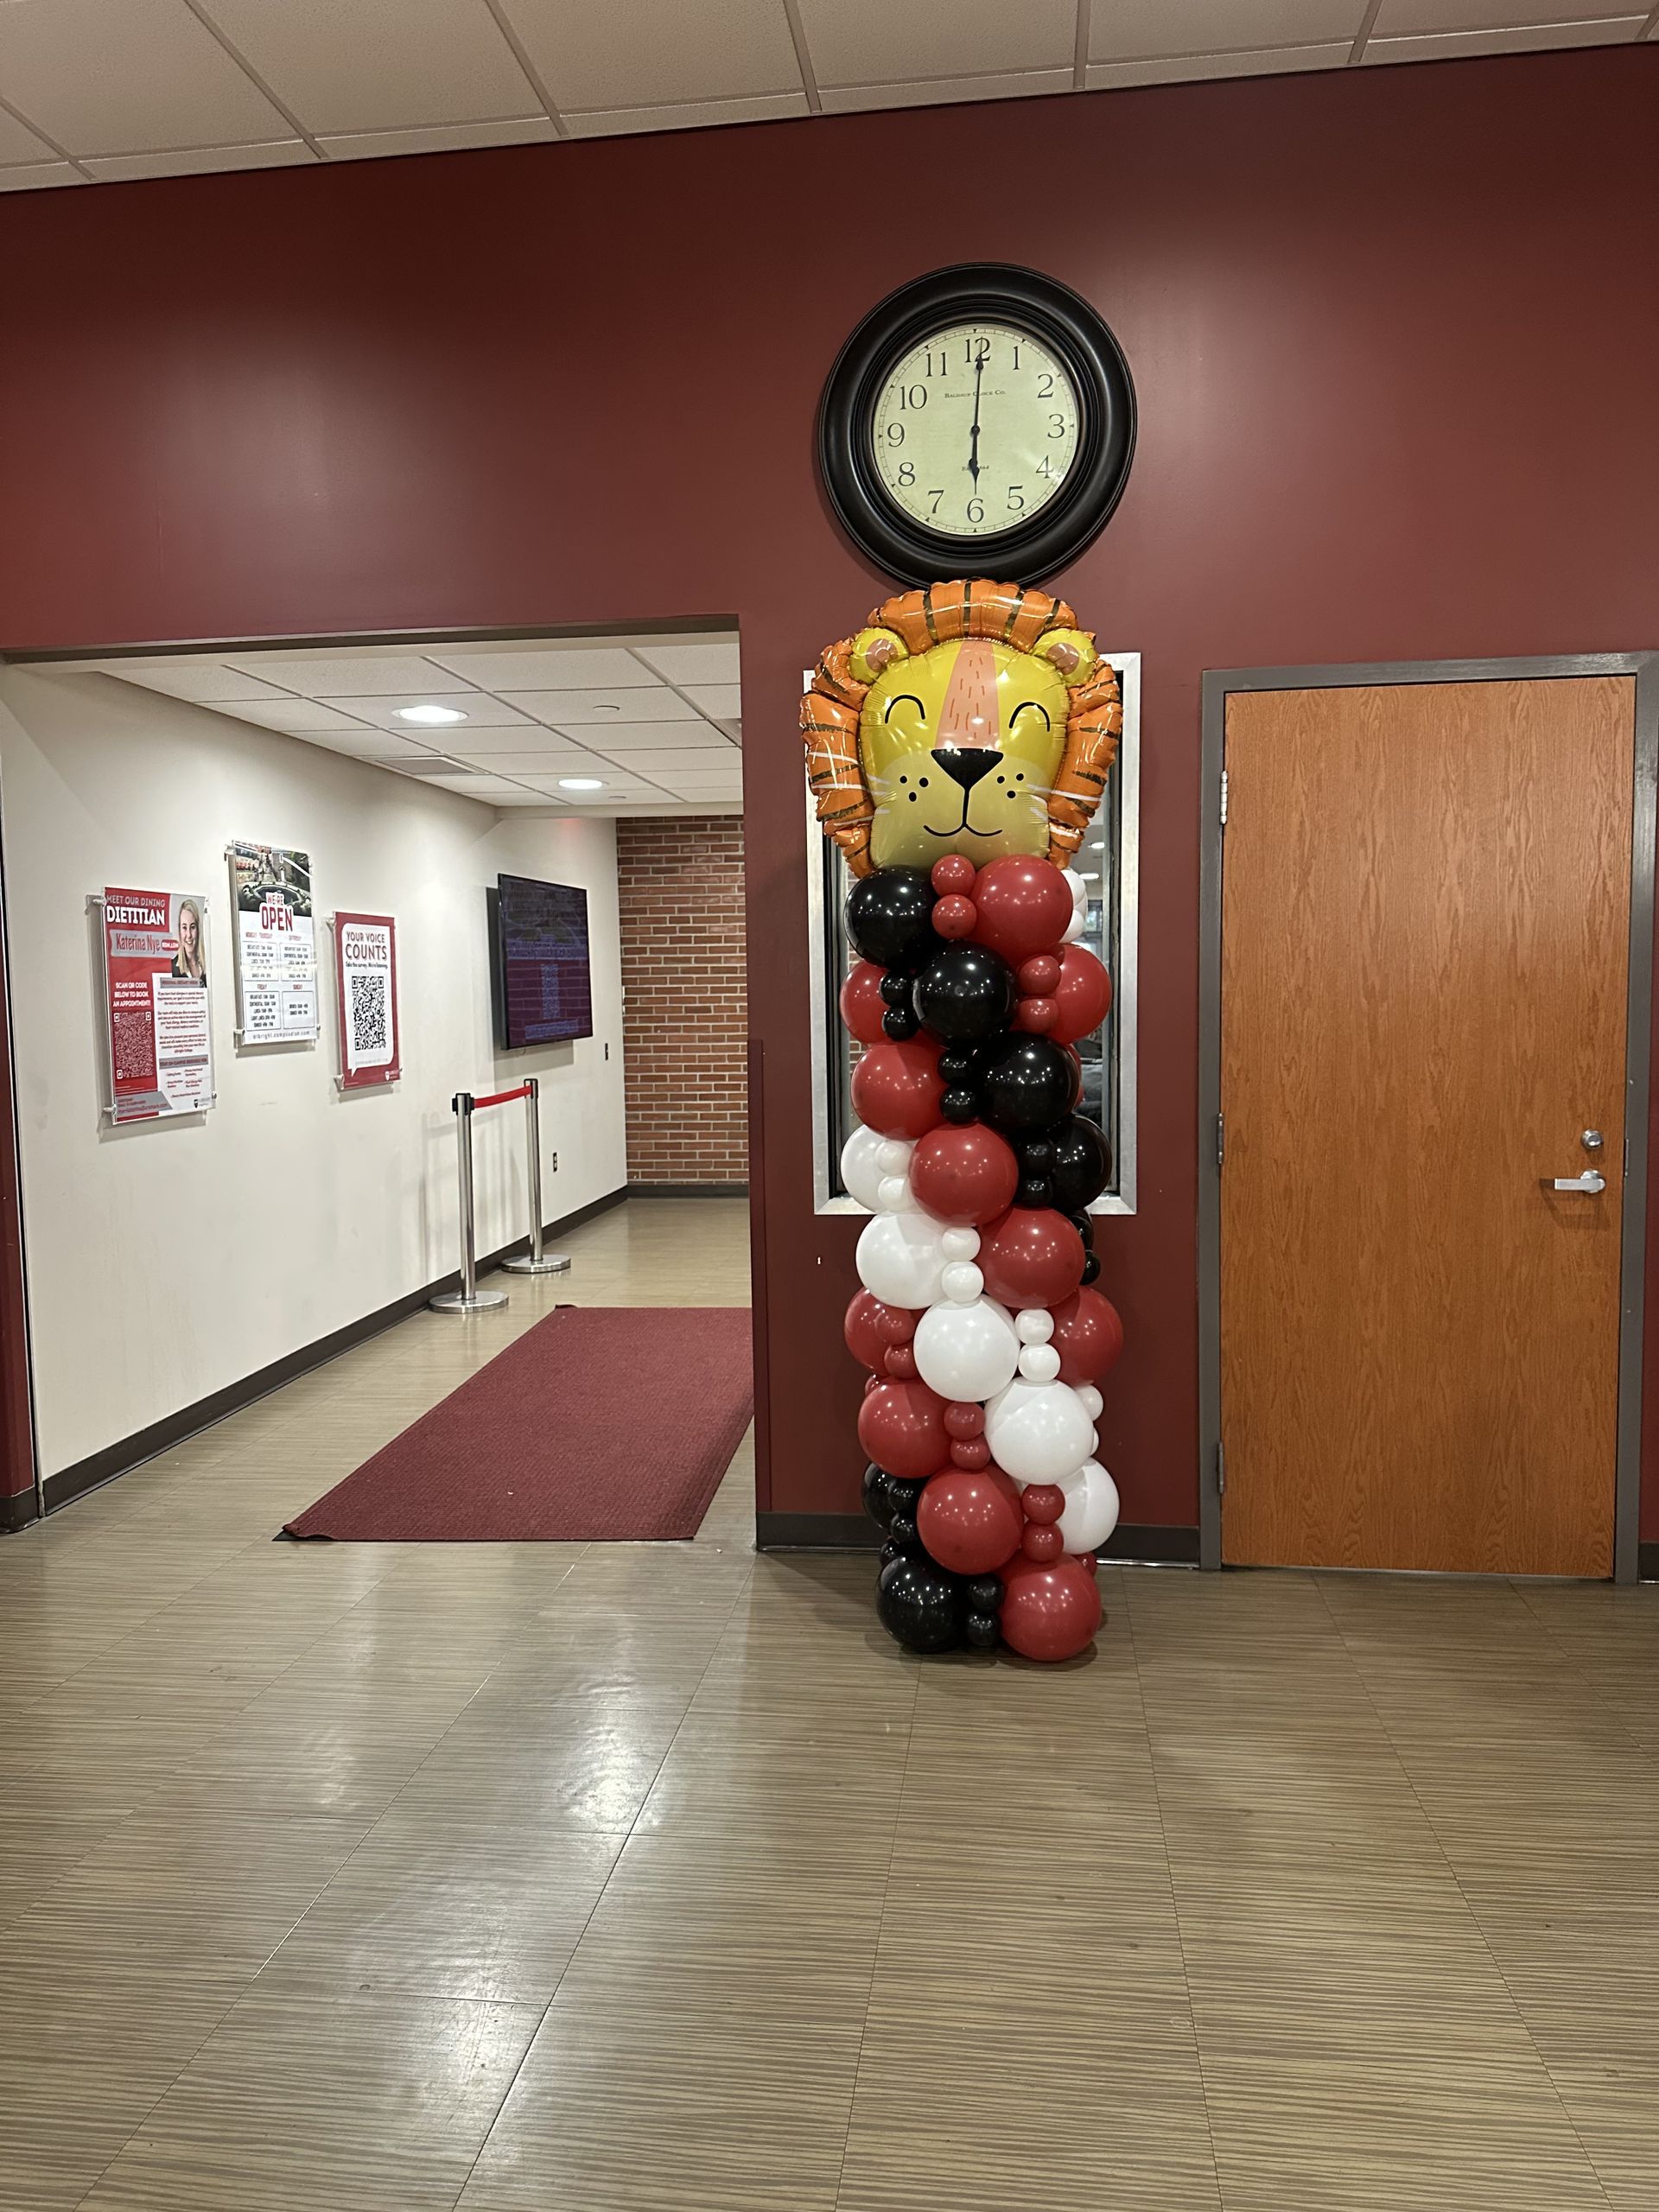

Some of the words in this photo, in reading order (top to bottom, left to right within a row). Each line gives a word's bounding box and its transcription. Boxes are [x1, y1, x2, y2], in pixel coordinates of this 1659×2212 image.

[965, 338, 991, 363] 12
[1013, 346, 1020, 370] 1
[926, 353, 947, 377] 11
[900, 385, 927, 410] 10
[1037, 374, 1054, 398] 2
[887, 423, 906, 447] 9
[1047, 414, 1065, 438] 3
[898, 462, 916, 486] 8
[1036, 455, 1054, 479] 4
[927, 489, 944, 513] 7
[1007, 486, 1025, 510] 5
[966, 498, 984, 523] 6
[106, 895, 124, 904] MEET
[125, 896, 139, 906] OUR
[141, 898, 166, 907] DINING
[106, 906, 165, 925] DIETITIAN
[261, 906, 293, 931] OPEN
[116, 933, 146, 950] Katerina
[147, 935, 161, 954] Nye
[346, 931, 364, 942] YOUR
[365, 932, 385, 944] VOICE
[346, 944, 387, 960] COUNTS
